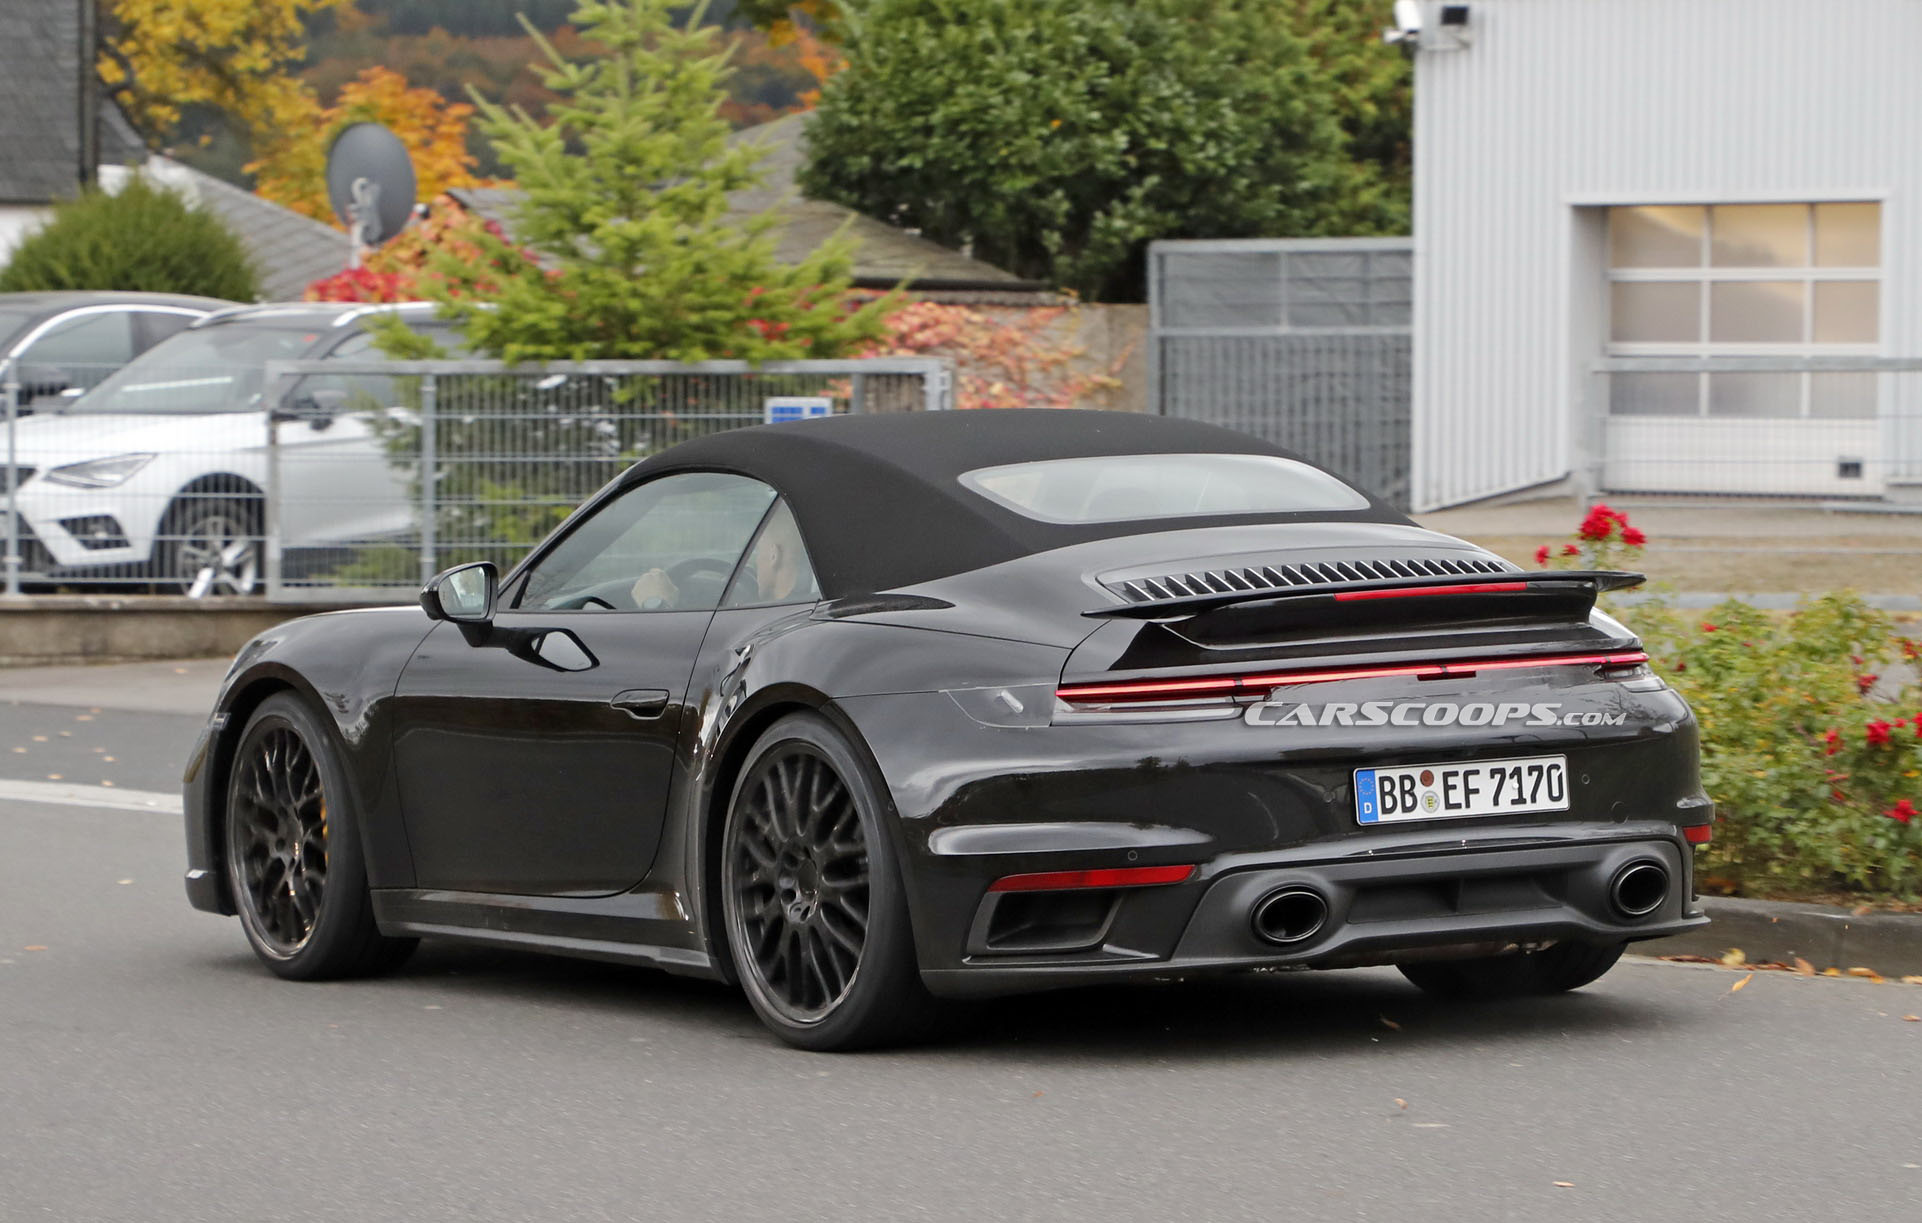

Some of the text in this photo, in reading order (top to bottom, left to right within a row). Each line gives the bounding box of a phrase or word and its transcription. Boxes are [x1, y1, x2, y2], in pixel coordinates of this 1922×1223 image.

[1378, 763, 1564, 815] BB EF 7170
[1364, 802, 1372, 814] D
